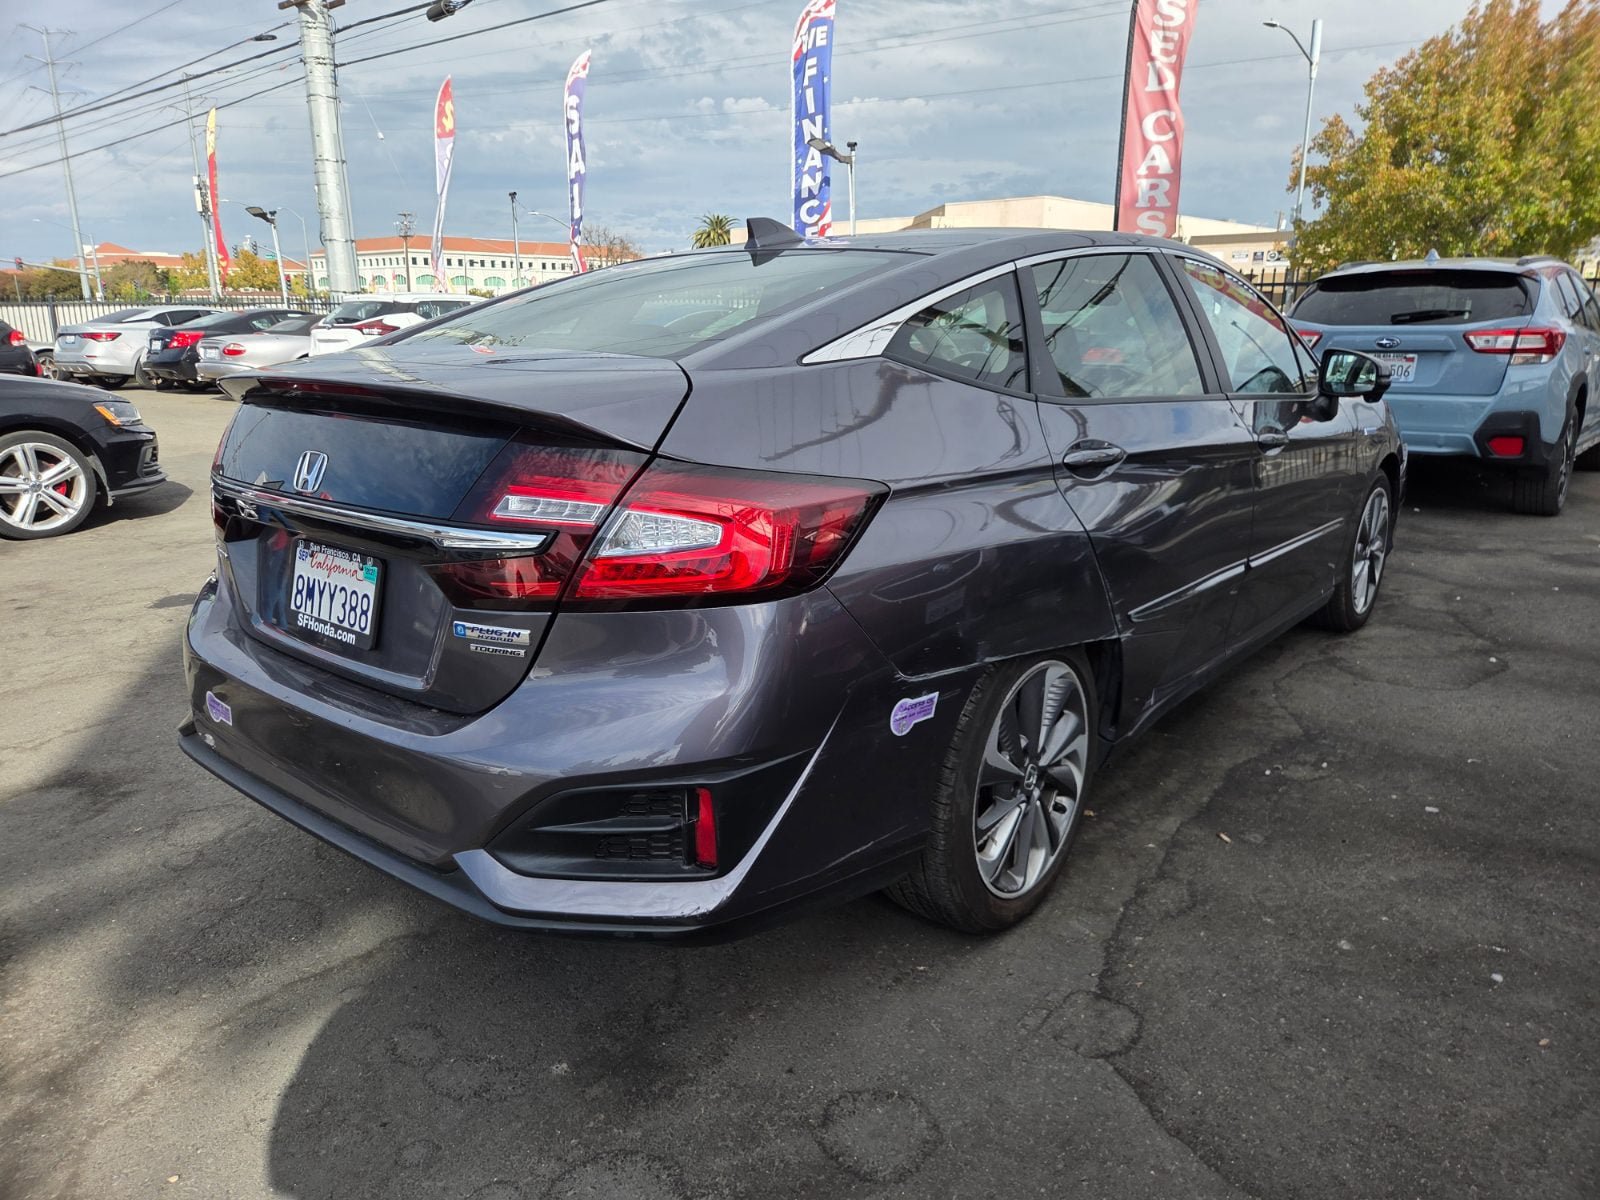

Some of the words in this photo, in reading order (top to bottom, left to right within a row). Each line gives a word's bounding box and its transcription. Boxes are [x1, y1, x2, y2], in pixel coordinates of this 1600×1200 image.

[1136, 108, 1176, 237] CARS
[310, 542, 320, 552] San
[321, 545, 351, 561] Francisco,
[352, 552, 361, 563] CA
[311, 551, 363, 581] California
[294, 574, 370, 632] 8MYY388
[297, 613, 356, 645] SFHonda.com
[470, 626, 521, 638] PLUG-IN
[477, 634, 514, 643] HYBRID
[475, 646, 521, 656] TOURING
